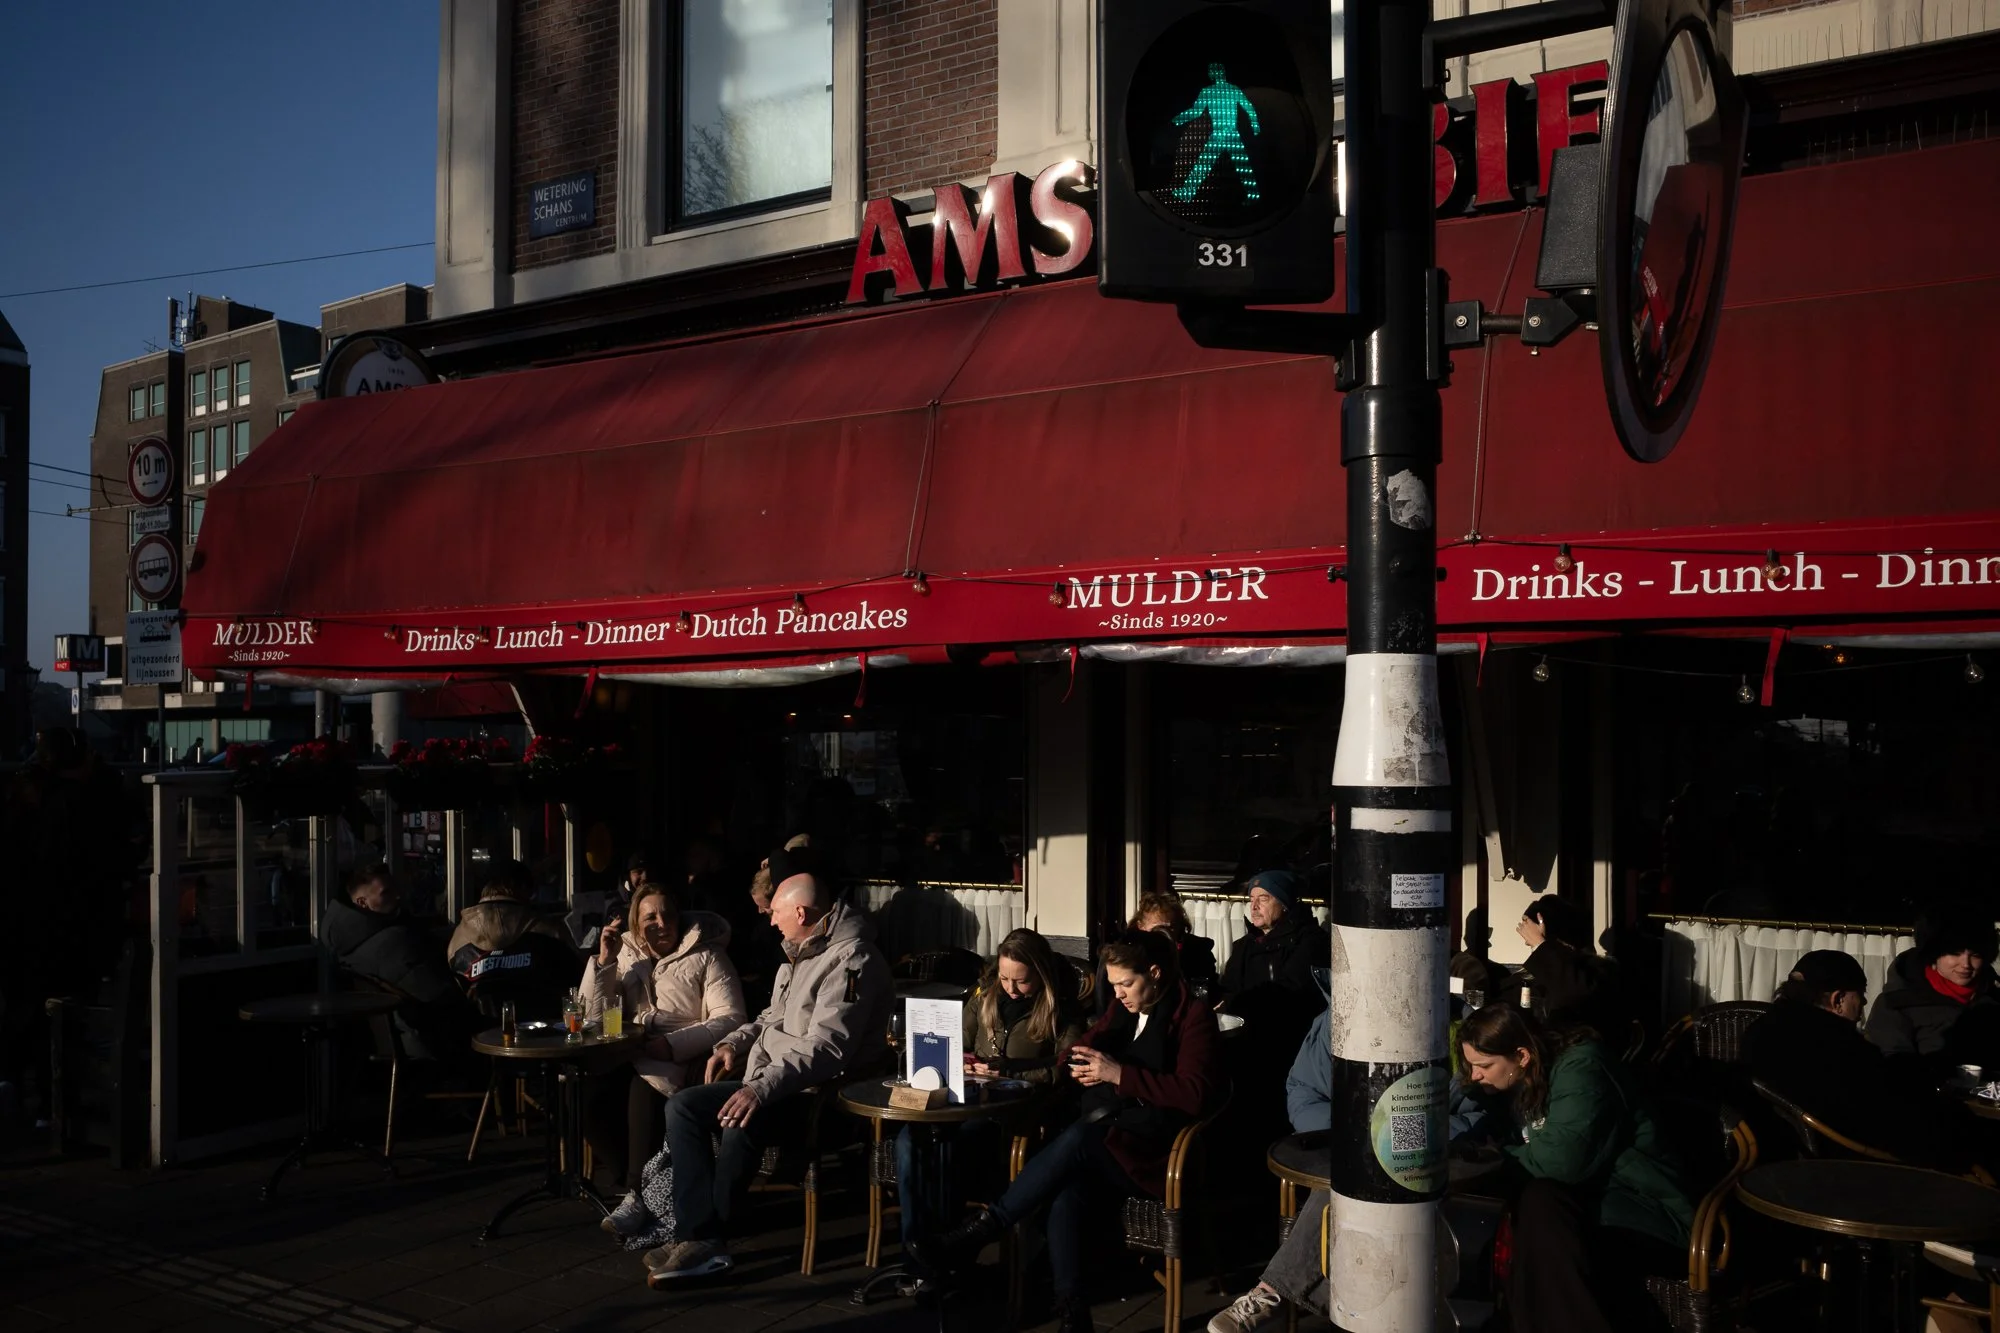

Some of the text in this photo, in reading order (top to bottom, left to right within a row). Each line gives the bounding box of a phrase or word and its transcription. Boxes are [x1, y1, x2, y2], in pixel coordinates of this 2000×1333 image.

[534, 178, 587, 203] WETERING
[534, 199, 573, 221] SCHANS
[555, 212, 587, 228] CENTRUM
[1198, 242, 1247, 268] 331
[136, 454, 166, 477] 10 m
[1066, 565, 1269, 609] MULDER
[1471, 560, 1624, 601] Drinks
[1669, 551, 1826, 596] Lunch
[212, 620, 315, 646] MULDER
[405, 626, 475, 652] Drinks
[494, 620, 564, 649] Lunch
[584, 618, 670, 646] Dinner
[690, 606, 767, 640] Dutch
[774, 600, 909, 635] Pancakes
[56, 637, 68, 659] M
[76, 637, 99, 660] M
[131, 653, 180, 666] uitgezonderd
[136, 669, 175, 681] lijnbussen
[1406, 1082, 1421, 1090] Hoe
[1391, 1093, 1425, 1102] kinderen
[1392, 1152, 1417, 1161] Wordt
